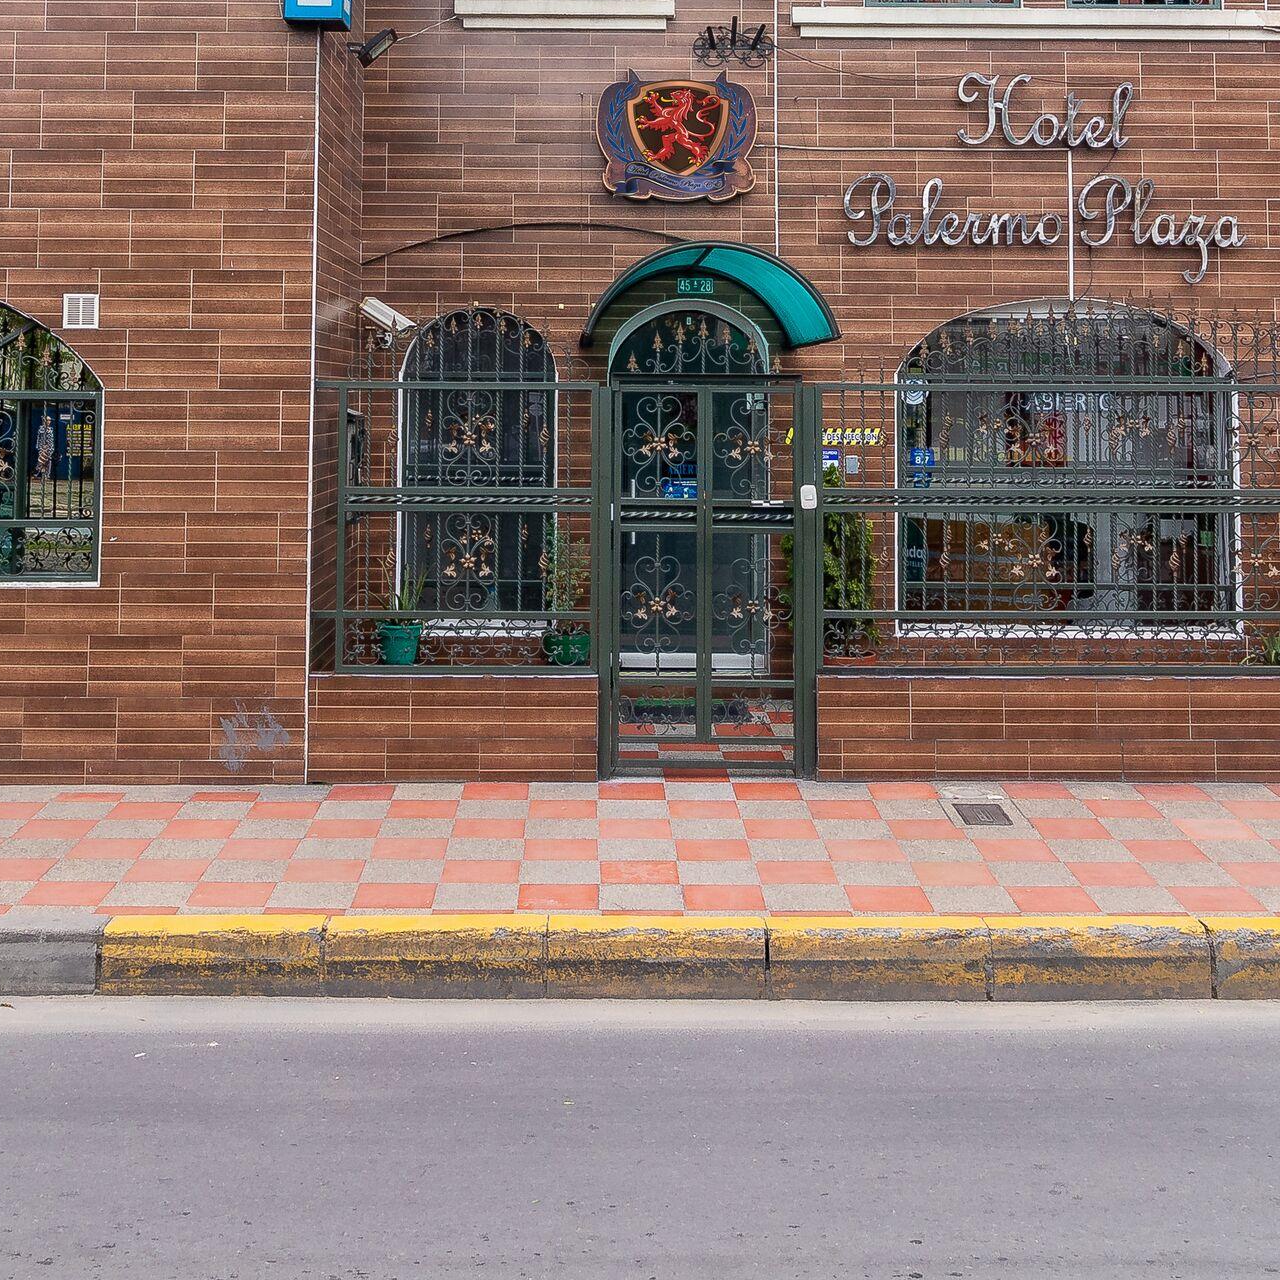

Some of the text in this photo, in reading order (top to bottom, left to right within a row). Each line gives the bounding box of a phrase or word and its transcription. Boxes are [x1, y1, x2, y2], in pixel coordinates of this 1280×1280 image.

[956, 71, 1134, 149] Hotel
[843, 172, 1248, 284] Palermo Plaza
[680, 280, 691, 291] 45
[700, 280, 711, 291] 28
